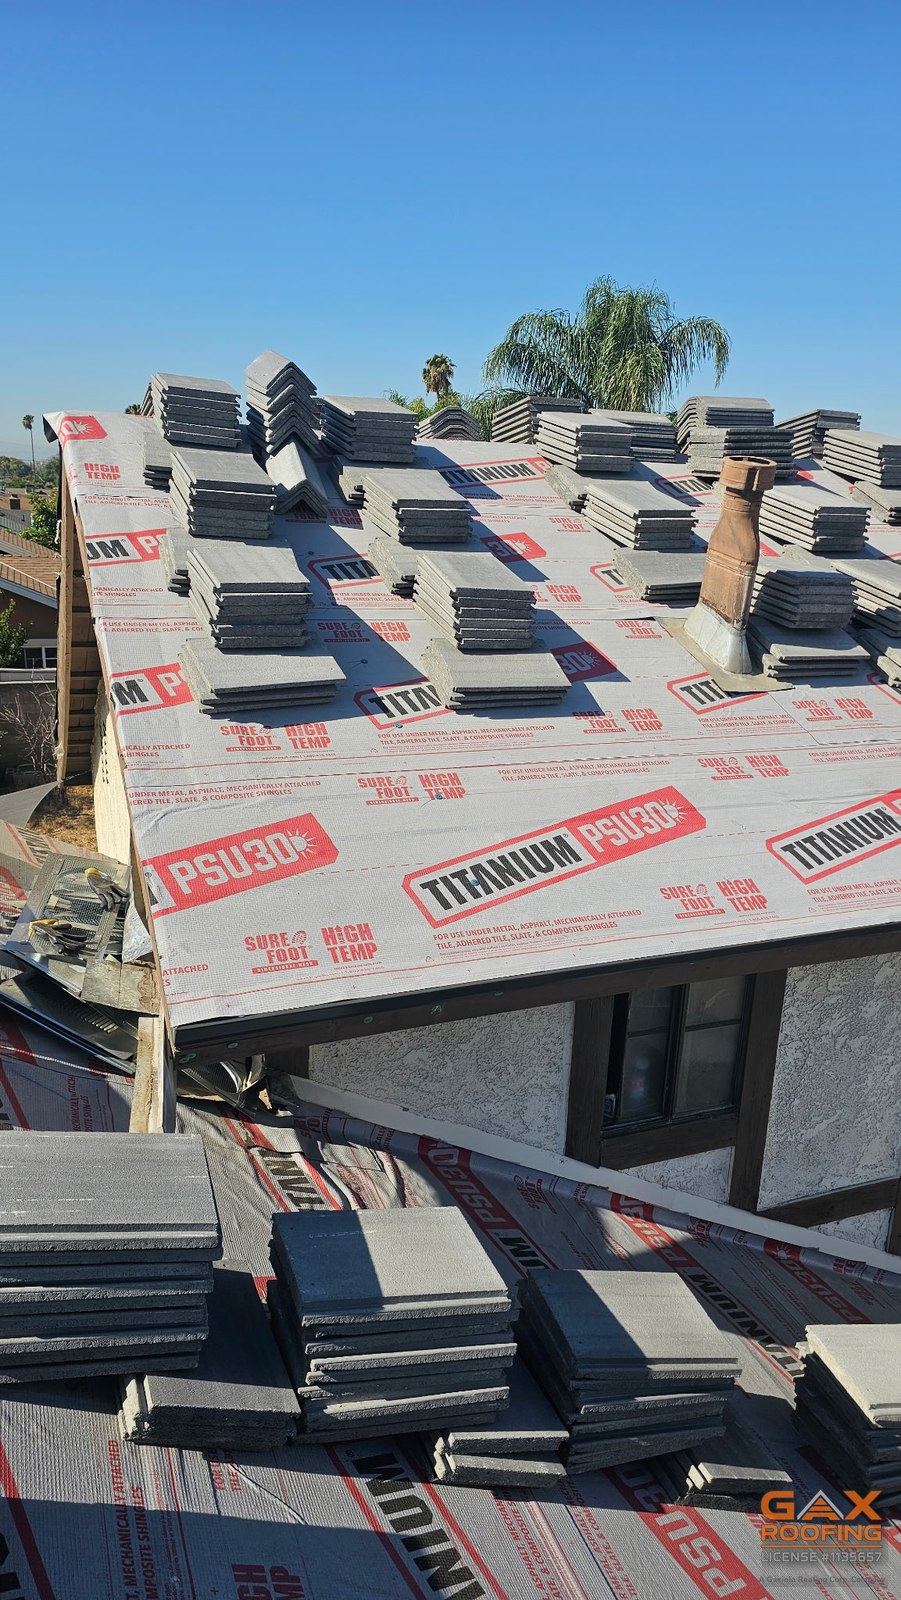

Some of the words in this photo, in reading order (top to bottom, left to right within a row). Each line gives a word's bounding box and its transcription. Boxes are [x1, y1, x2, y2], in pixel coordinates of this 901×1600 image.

[84, 463, 119, 474] HIGH
[438, 463, 536, 486] TITANIUM
[86, 472, 120, 481] TEMP
[545, 584, 578, 594] HIGH
[552, 594, 582, 602] TEMP
[317, 622, 350, 632] SURE
[370, 622, 408, 632] HIGH
[332, 631, 363, 639] FOOT
[374, 632, 411, 642] TEMP
[792, 700, 820, 709] SURE
[833, 698, 867, 708] HIGH
[621, 709, 658, 720] HIGH
[809, 708, 834, 717] FOOT
[843, 708, 874, 719] TEMP
[284, 723, 328, 737] HIGH
[589, 719, 618, 728] FOOT
[629, 720, 664, 732] TEMP
[220, 726, 258, 736] SURE
[452, 728, 480, 736] ASPHALT,
[482, 726, 526, 734] MECHANICALLY
[238, 736, 273, 746] FOOT
[289, 736, 332, 750] TEMP
[596, 762, 640, 770] MECHANICALLY
[698, 757, 728, 768] SURE
[744, 754, 784, 768] HIGH
[714, 766, 744, 776] FOOT
[755, 767, 790, 778] TEMP
[358, 776, 395, 788] SURE
[418, 772, 462, 788] HIGH
[128, 791, 157, 799] UNDER
[188, 786, 225, 796] ASPHALT,
[226, 782, 284, 792] MECHANICALLY
[284, 780, 322, 789] ATTACHED
[209, 792, 256, 802] COMPOSITE
[256, 789, 292, 798] SHINGLES
[376, 786, 411, 798] FOOT
[425, 787, 468, 801] TEMP
[780, 808, 901, 870] TITANIUM
[419, 834, 583, 911] TITANIUM
[578, 801, 678, 854] PSU30
[168, 832, 300, 894] PSU30
[660, 885, 698, 900] SURE
[716, 878, 761, 897] HIGH
[680, 896, 716, 911] FOOT
[726, 895, 768, 912] TEMP
[828, 893, 856, 902] ADHERED
[466, 928, 492, 938] UNDER
[492, 924, 520, 934] METAL,
[520, 920, 554, 930] ASPHALT,
[554, 913, 606, 926] MECHANICALLY
[607, 909, 642, 918] ATTACHED
[322, 923, 374, 946] HIGH
[436, 942, 456, 950] TILE,
[456, 937, 492, 948] ADHERED
[492, 935, 512, 944] TILE,
[512, 932, 536, 941] SLATE,
[542, 924, 584, 936] COMPOSITE
[584, 920, 618, 932] SHINGLES
[244, 932, 291, 951] SURE
[266, 946, 310, 964] FOOT
[327, 942, 378, 964] TEMP
[162, 964, 209, 977] ATTACHED
[108, 1440, 124, 1494] ATTACHED
[131, 1487, 151, 1543] SHINGLES
[114, 1494, 138, 1587] MECHANICALLY
[509, 1504, 544, 1566] COMPOSITE
